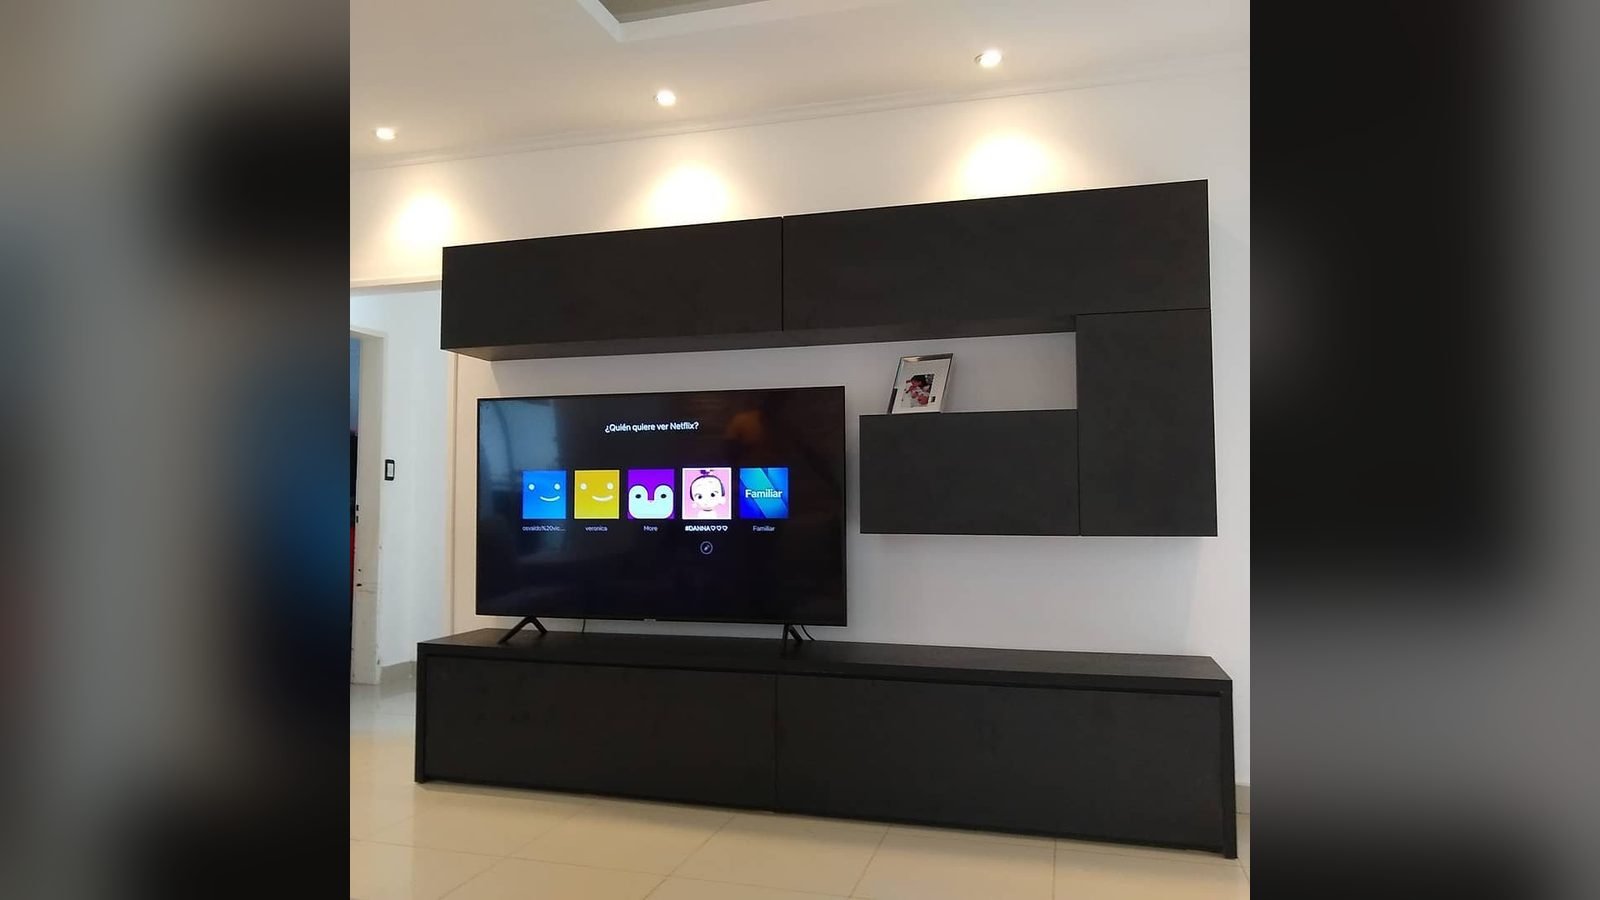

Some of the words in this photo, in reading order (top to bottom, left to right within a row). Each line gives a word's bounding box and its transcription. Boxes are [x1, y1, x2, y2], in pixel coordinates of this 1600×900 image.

[604, 423, 631, 433] ¿Quién
[632, 423, 656, 432] quiere
[670, 421, 700, 430] Netflix?
[745, 488, 783, 498] Familiar
